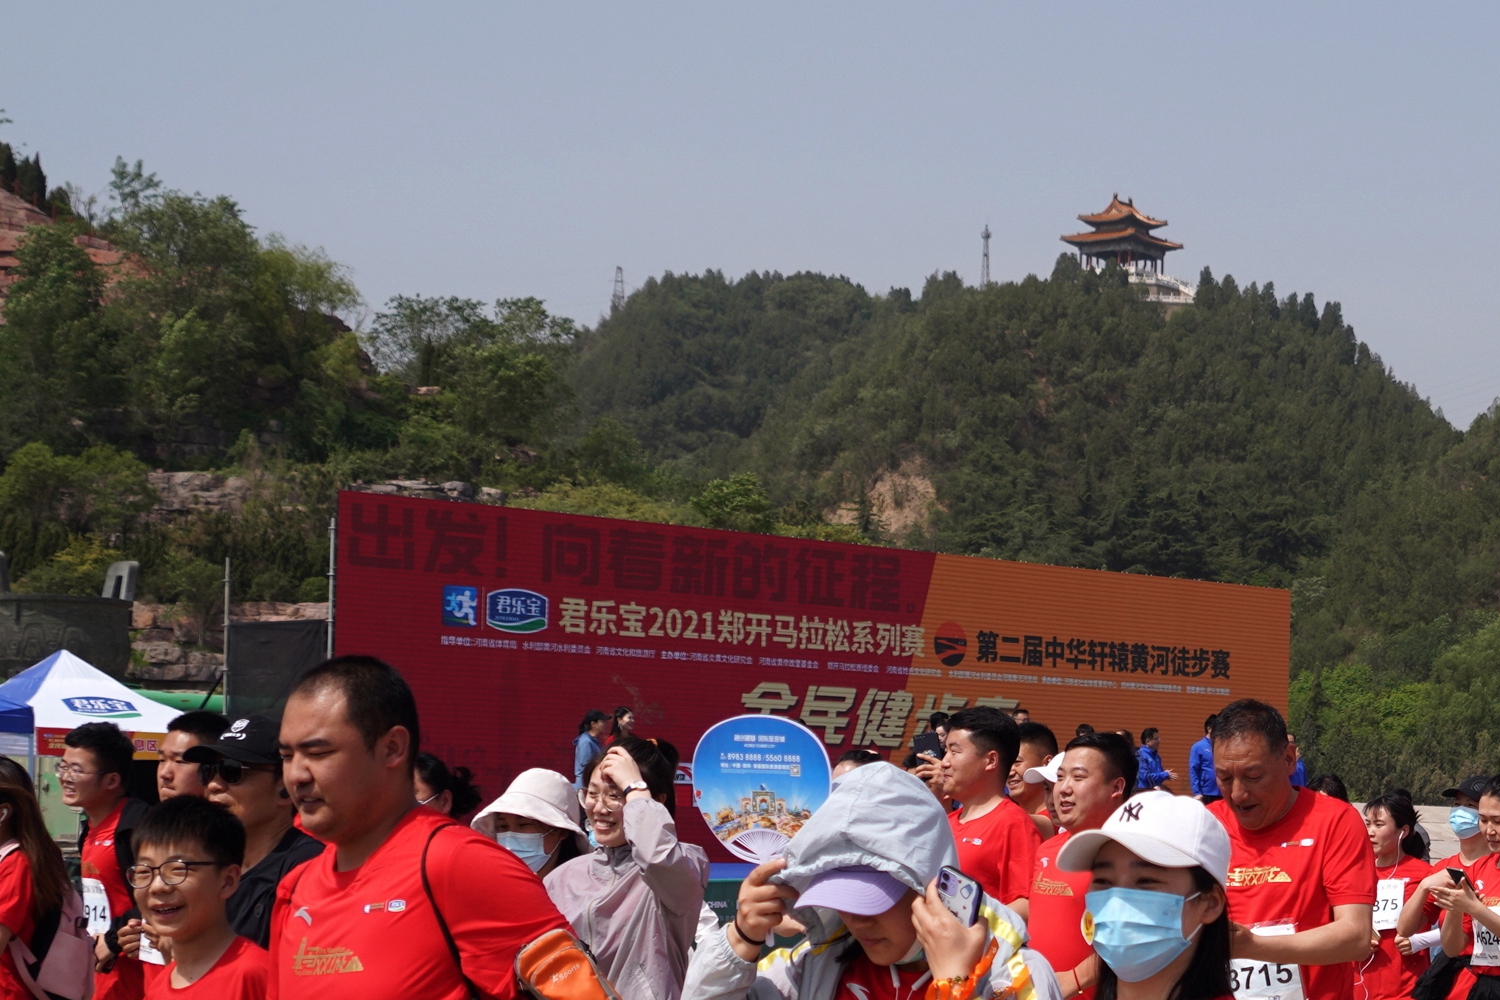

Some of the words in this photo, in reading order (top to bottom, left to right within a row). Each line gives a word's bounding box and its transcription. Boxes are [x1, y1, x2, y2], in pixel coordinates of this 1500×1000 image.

[495, 595, 542, 616] 君乐宝
[558, 596, 926, 658] 君乐宝2021郑开马拉松系列赛
[976, 630, 1231, 680] 第二届中华轩辕黄河徒步赛
[84, 904, 107, 922] 914
